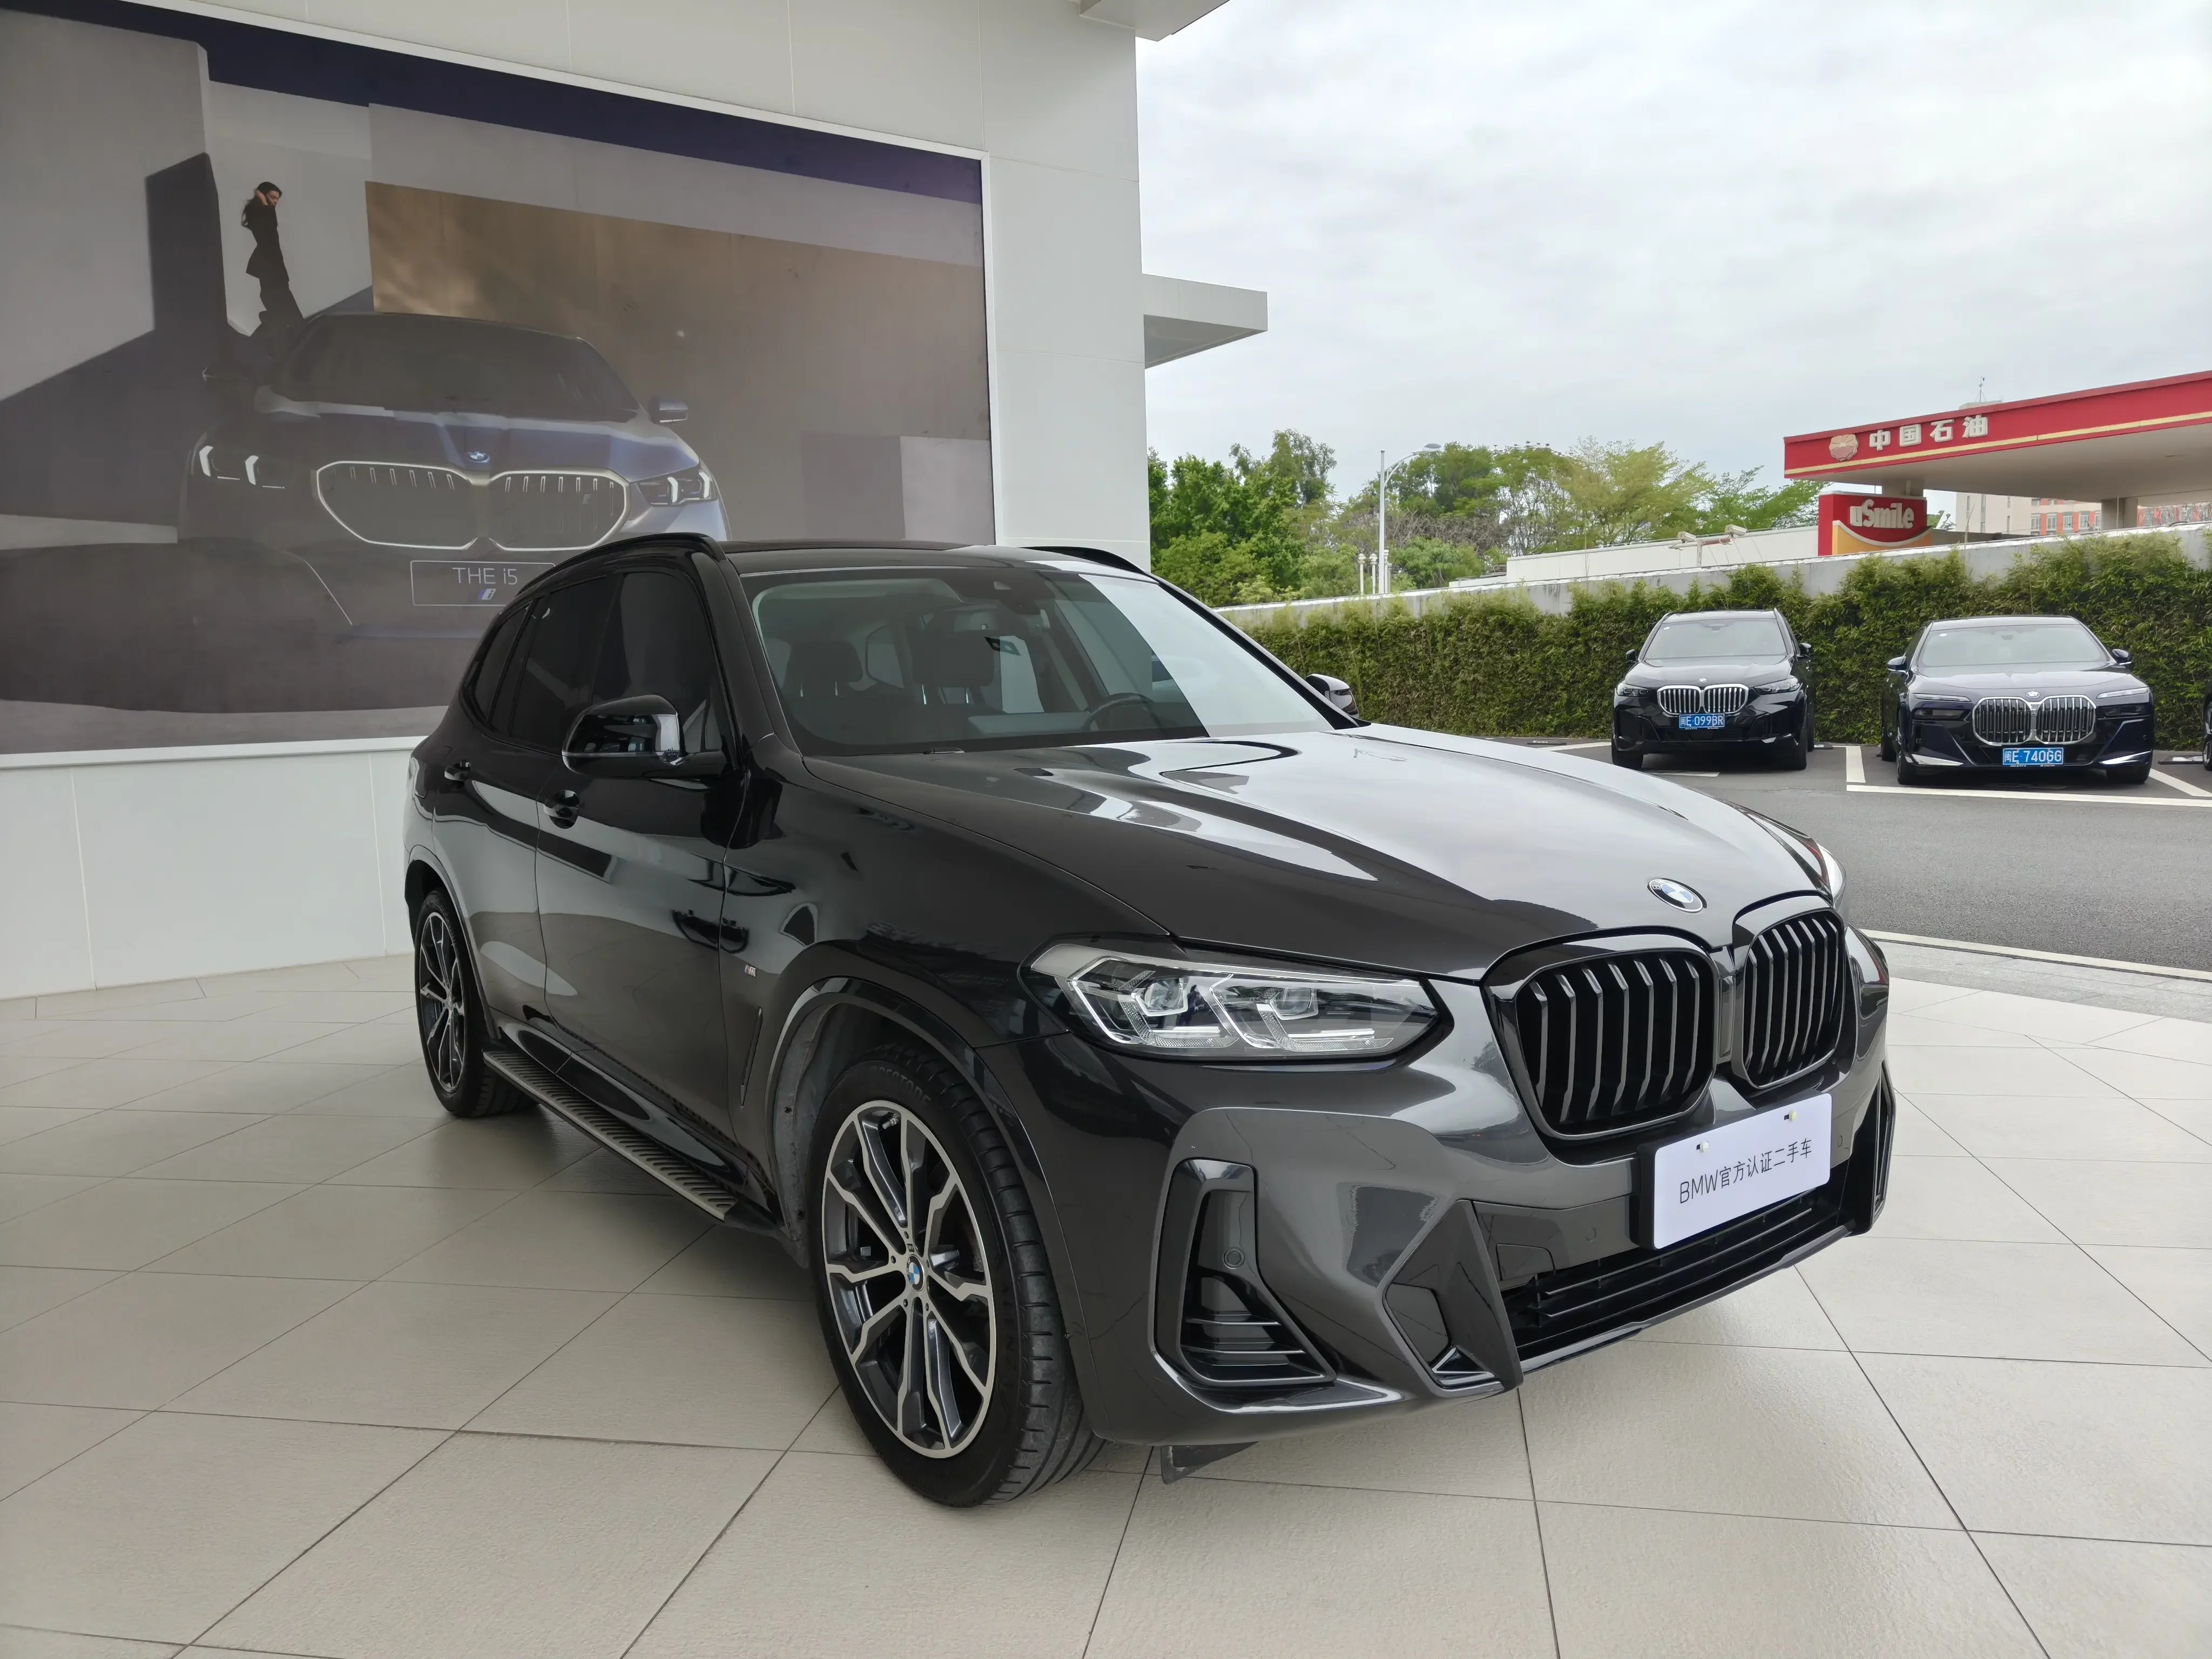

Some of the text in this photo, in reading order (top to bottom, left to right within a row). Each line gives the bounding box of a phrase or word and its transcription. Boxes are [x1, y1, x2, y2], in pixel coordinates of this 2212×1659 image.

[1869, 414, 1989, 451] 中国石油
[1850, 499, 1914, 529] uSmile
[453, 567, 518, 585] THE i5
[1680, 1138, 1812, 1203] BMW官方认证二手车
